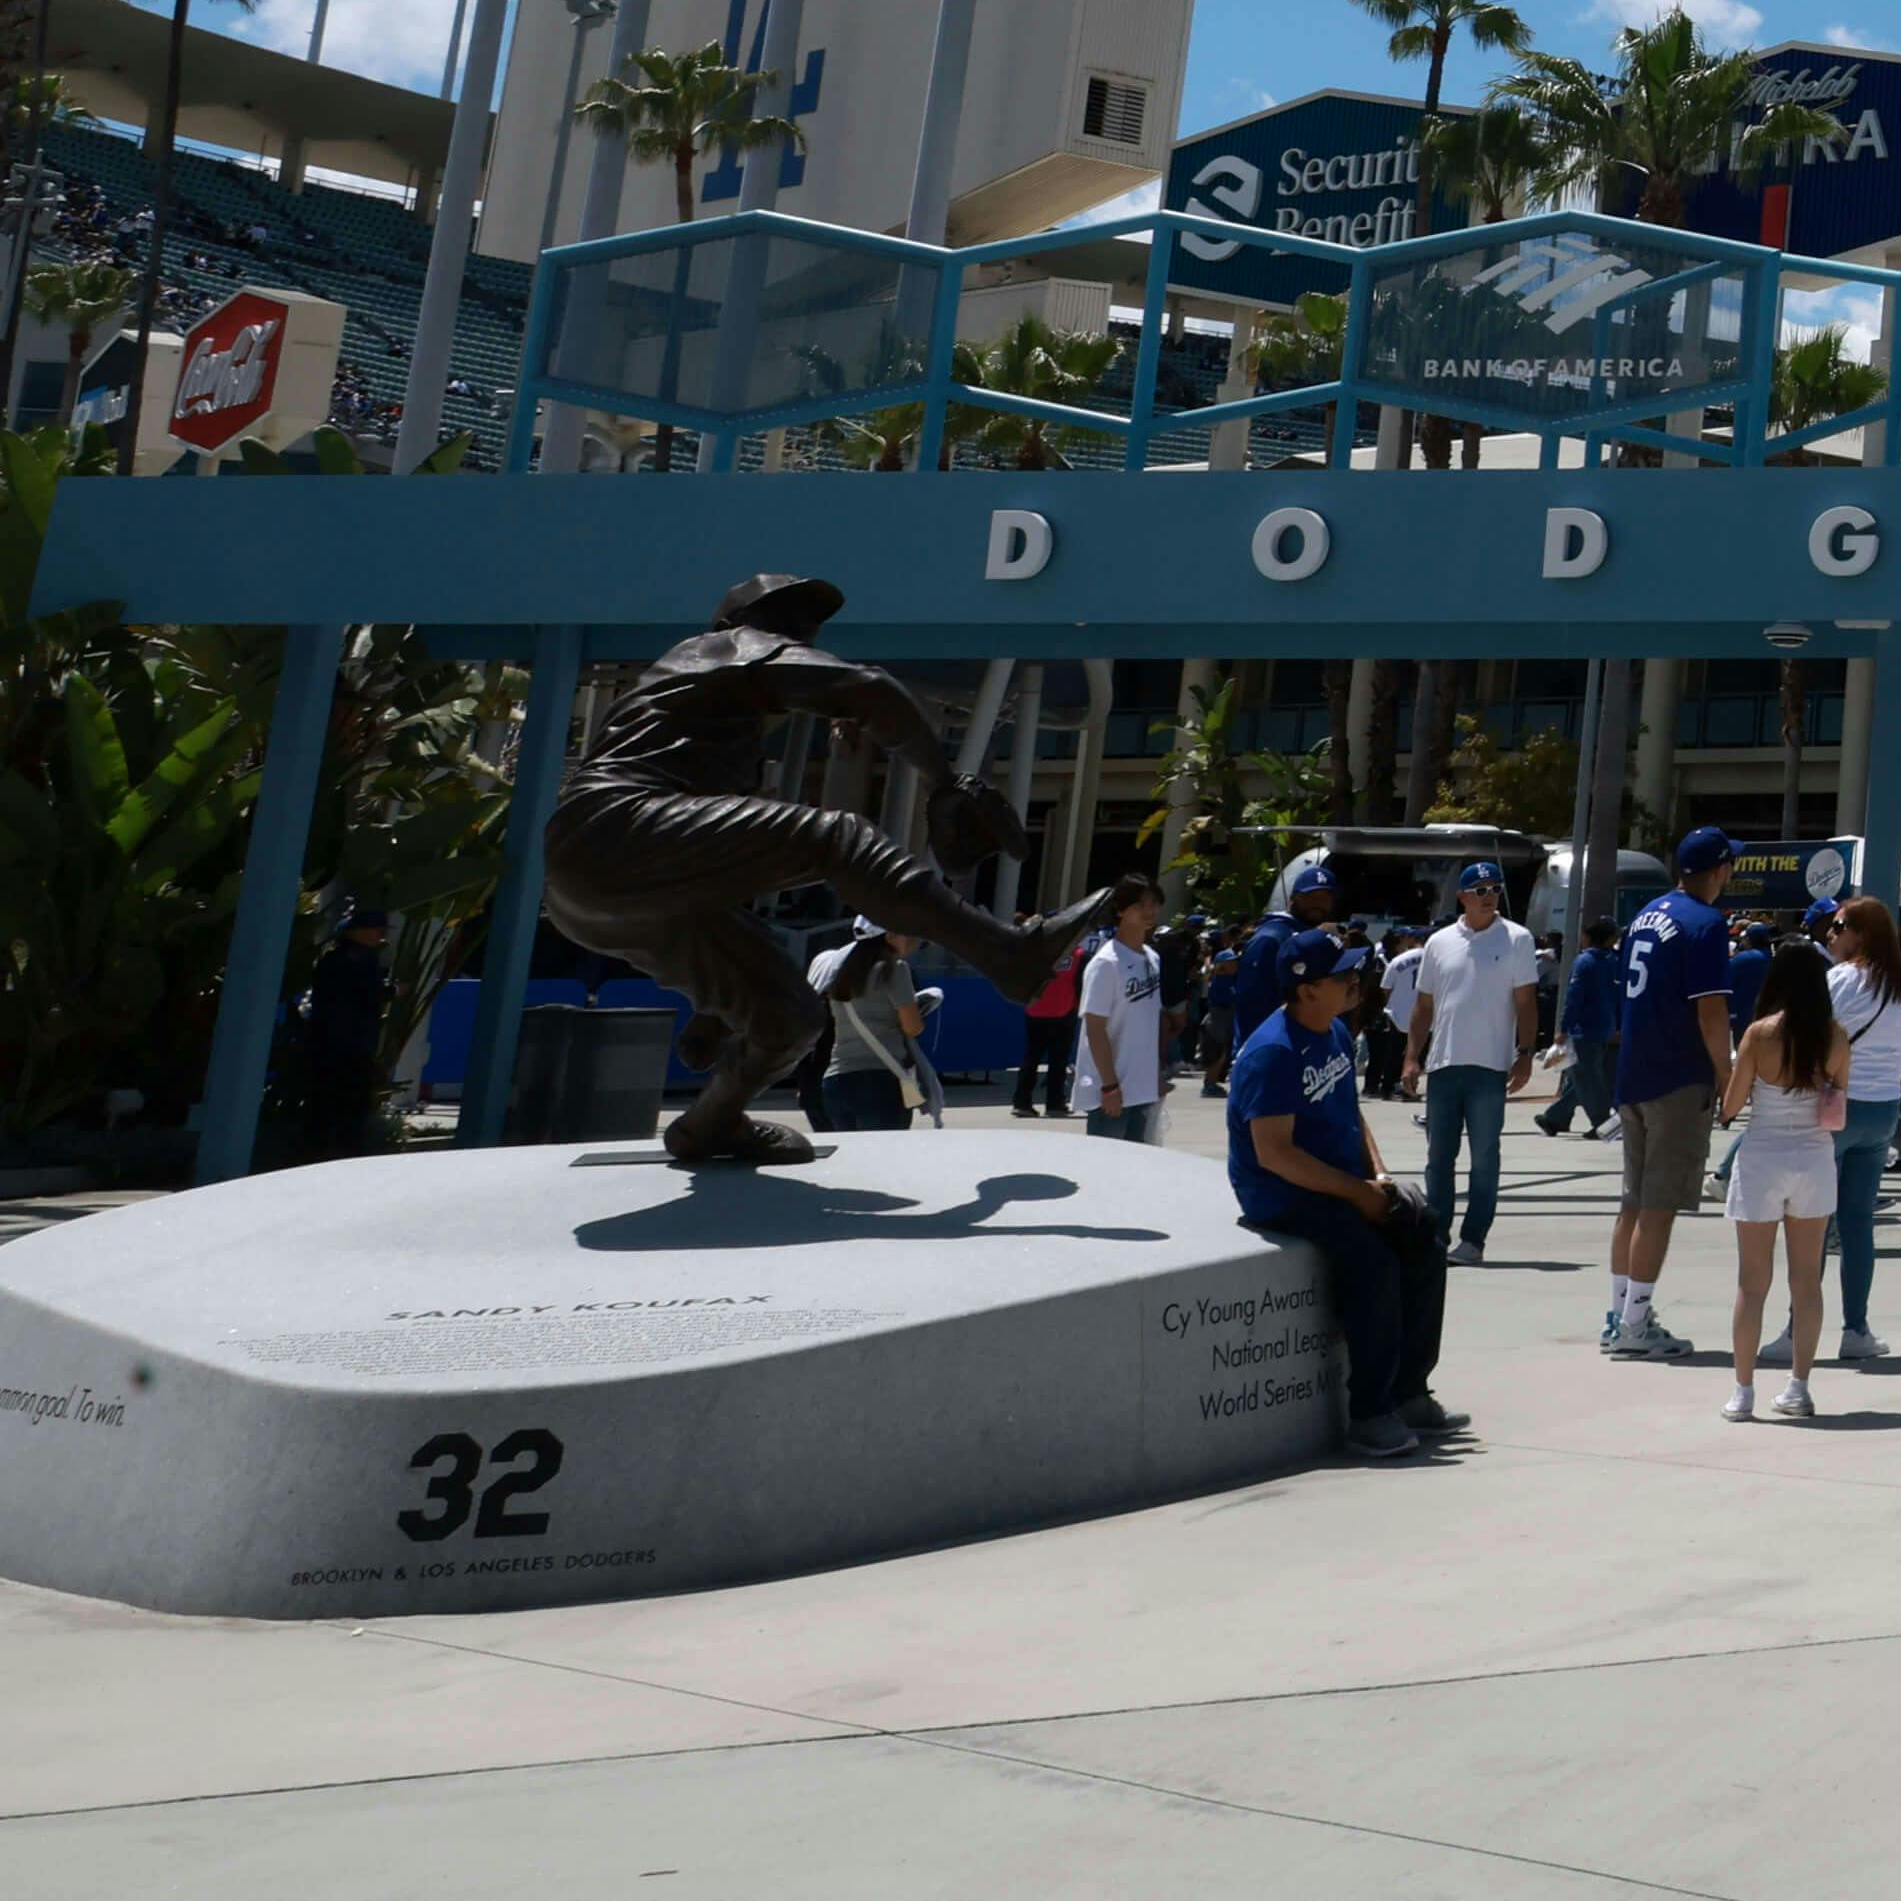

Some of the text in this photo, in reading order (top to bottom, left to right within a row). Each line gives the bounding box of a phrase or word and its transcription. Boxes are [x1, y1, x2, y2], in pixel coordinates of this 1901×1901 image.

[1277, 135, 1421, 197] Securit
[1271, 195, 1417, 256] Benefit
[1423, 357, 1684, 378] BANK OF AMERICA
[1770, 854, 1800, 872] THE
[1629, 911, 1680, 944] FREEMAN
[1626, 940, 1654, 998] 5
[385, 1294, 773, 1322] SANDY KOUFAX
[1162, 1302, 1192, 1340] Cy
[1197, 1295, 1256, 1327] Young
[1212, 1326, 1290, 1372] National
[74, 1388, 95, 1423] To
[1200, 1379, 1260, 1421] World
[1263, 1375, 1314, 1408] Series
[396, 1427, 564, 1542] 32
[291, 1549, 657, 1587] BROOKLYN & LOS ANGELES DODGERS
